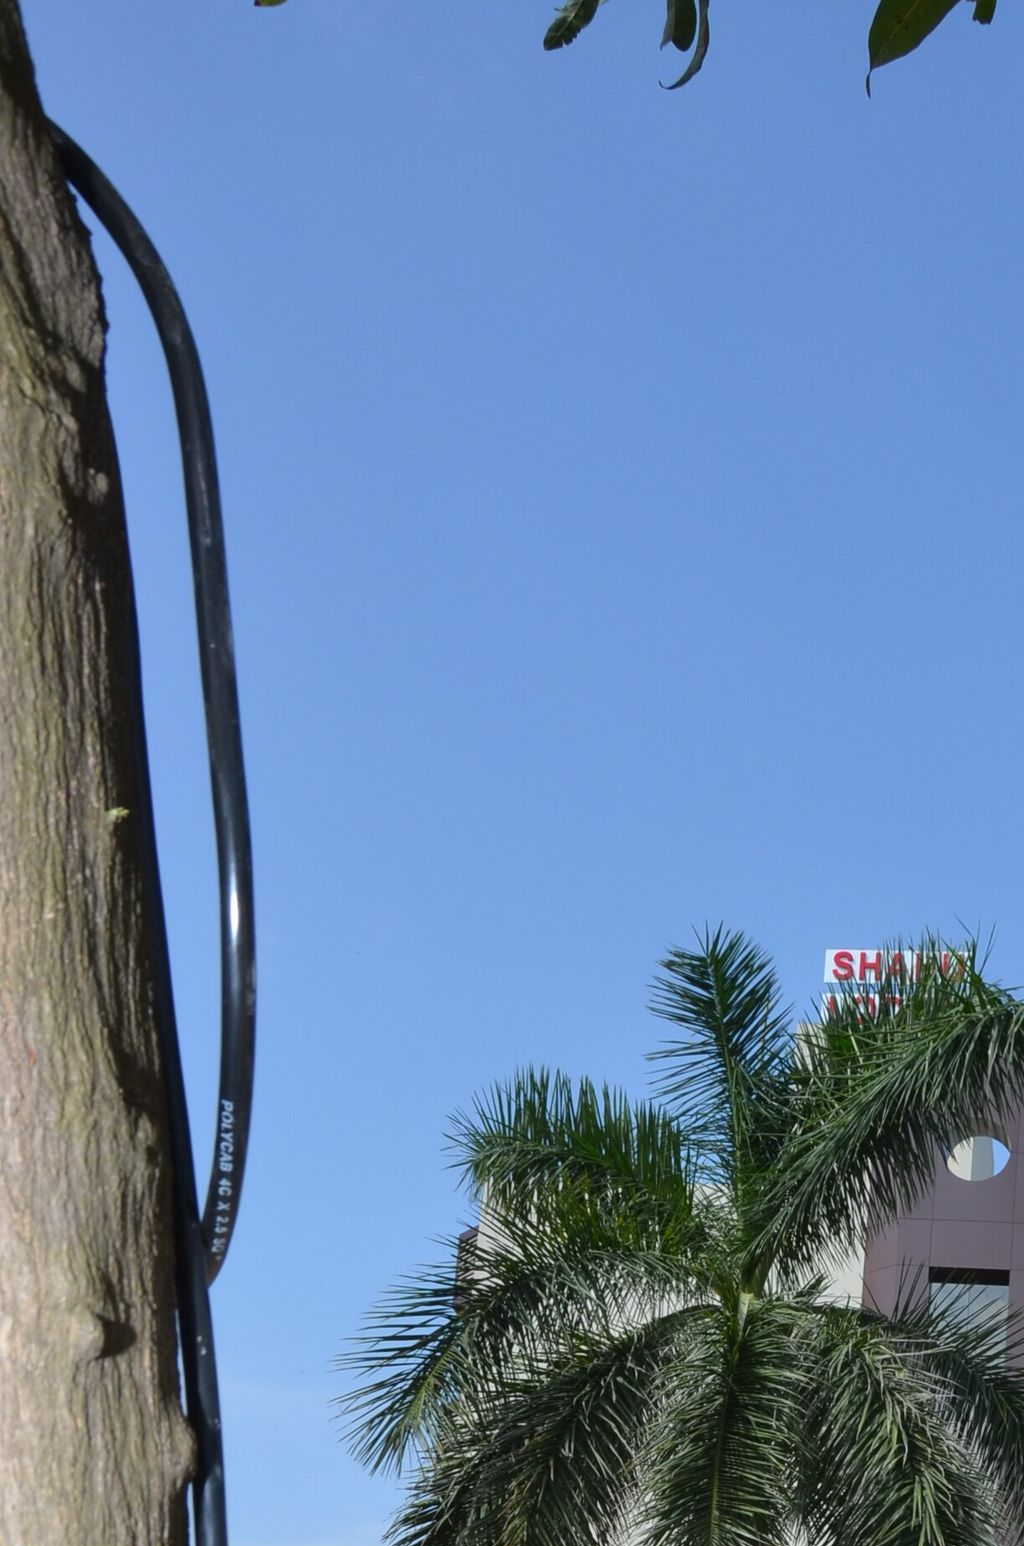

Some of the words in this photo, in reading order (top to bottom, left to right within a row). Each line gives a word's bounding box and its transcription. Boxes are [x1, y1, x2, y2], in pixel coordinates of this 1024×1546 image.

[219, 1099, 235, 1172] POLYCAB
[217, 1177, 232, 1197] 4C
[216, 1201, 231, 1212] X
[214, 1216, 229, 1234] 2.5
